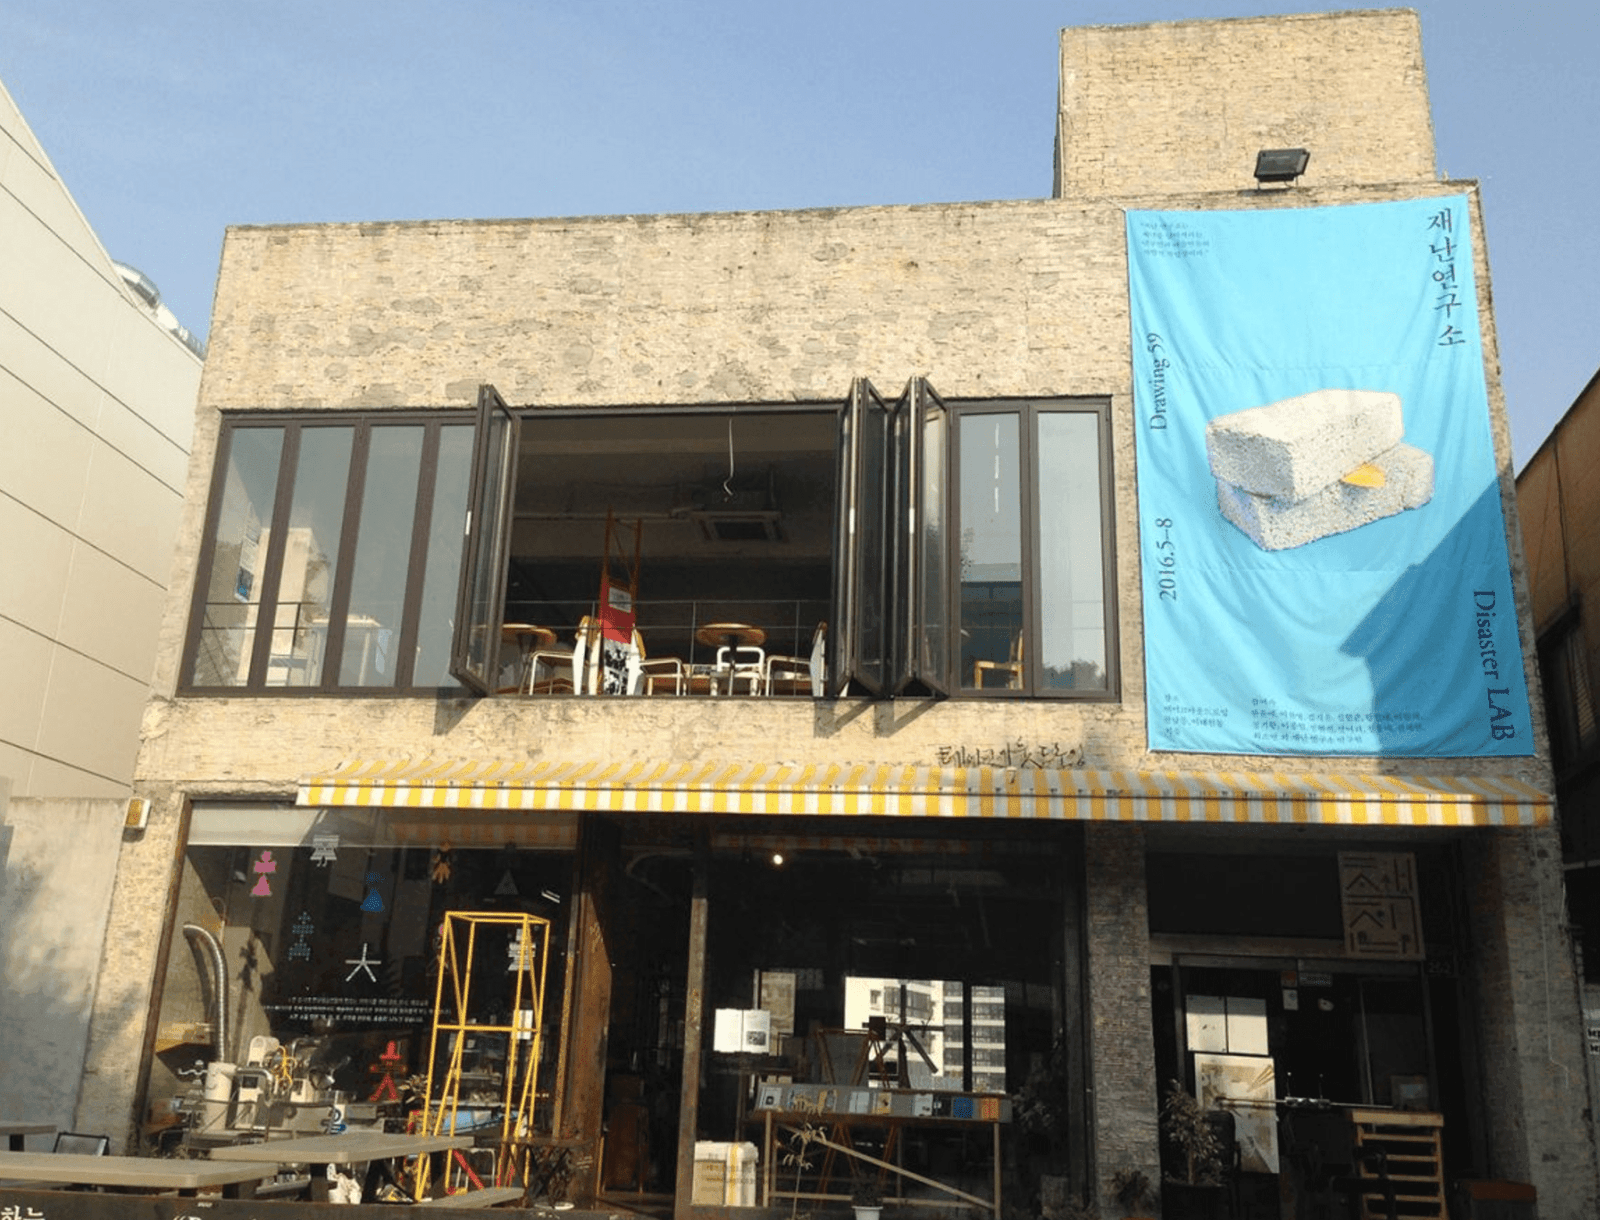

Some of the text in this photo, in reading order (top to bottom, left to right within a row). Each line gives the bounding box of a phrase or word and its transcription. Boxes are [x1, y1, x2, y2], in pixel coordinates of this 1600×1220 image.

[1427, 207, 1467, 348] 재난연구소
[1148, 333, 1170, 430] Drawing 59
[1474, 591, 1515, 740] Disaster LAB
